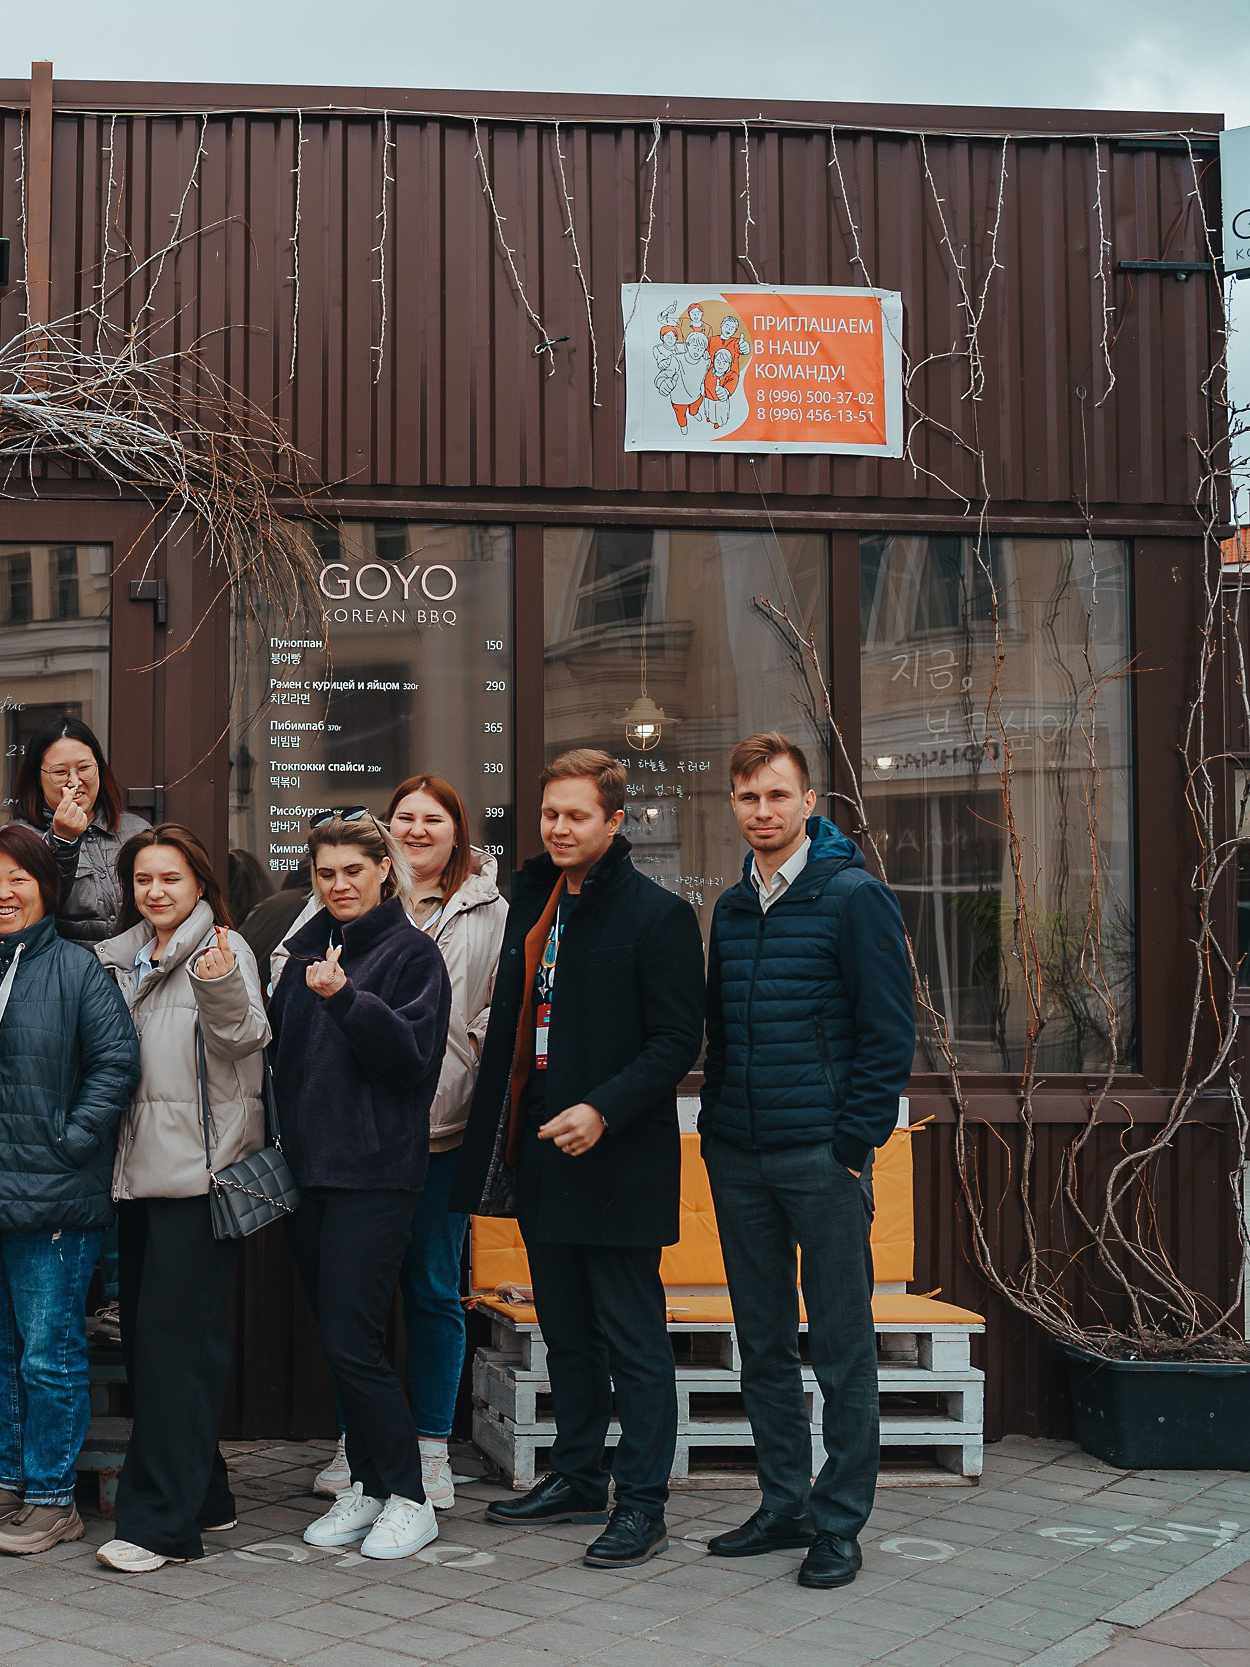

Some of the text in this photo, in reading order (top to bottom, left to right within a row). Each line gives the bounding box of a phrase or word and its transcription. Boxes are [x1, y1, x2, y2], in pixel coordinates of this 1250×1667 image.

[753, 315, 874, 334] ПРИГЛАШАЕМ
[754, 339, 821, 356] В НАШУ
[754, 363, 846, 383] КОМАНДУ!
[756, 389, 874, 405] 8 (996) 500-37-02
[757, 407, 874, 423] 8 (996) 456-13-51
[319, 563, 457, 601] GOYO
[322, 608, 457, 626] KOREAN BBQ
[270, 637, 323, 649] Пуноппан
[485, 640, 503, 650] 150
[270, 652, 301, 665] 붕어빵
[270, 678, 302, 689] Рамен
[304, 681, 310, 689] с
[313, 679, 355, 691] курицей
[358, 681, 365, 689] и
[366, 680, 399, 691] яйцом
[485, 680, 505, 691] 290
[270, 693, 310, 704] 치킨라면
[270, 720, 325, 731] Пибимпаб
[484, 722, 503, 733] 365
[270, 735, 301, 748] 비빔밥
[269, 760, 325, 771] Ттокпокки
[328, 761, 365, 772] спайси
[483, 762, 504, 773] 330
[638, 759, 668, 772] 하늘을
[677, 760, 710, 773] 우러러
[270, 776, 300, 788] 떡볶이
[626, 784, 645, 796] 럼이
[485, 807, 504, 818] 399
[270, 820, 300, 833] 밥버거
[269, 843, 310, 854] Кимпаб
[483, 845, 504, 855] 330
[269, 858, 300, 871] 햄김밥
